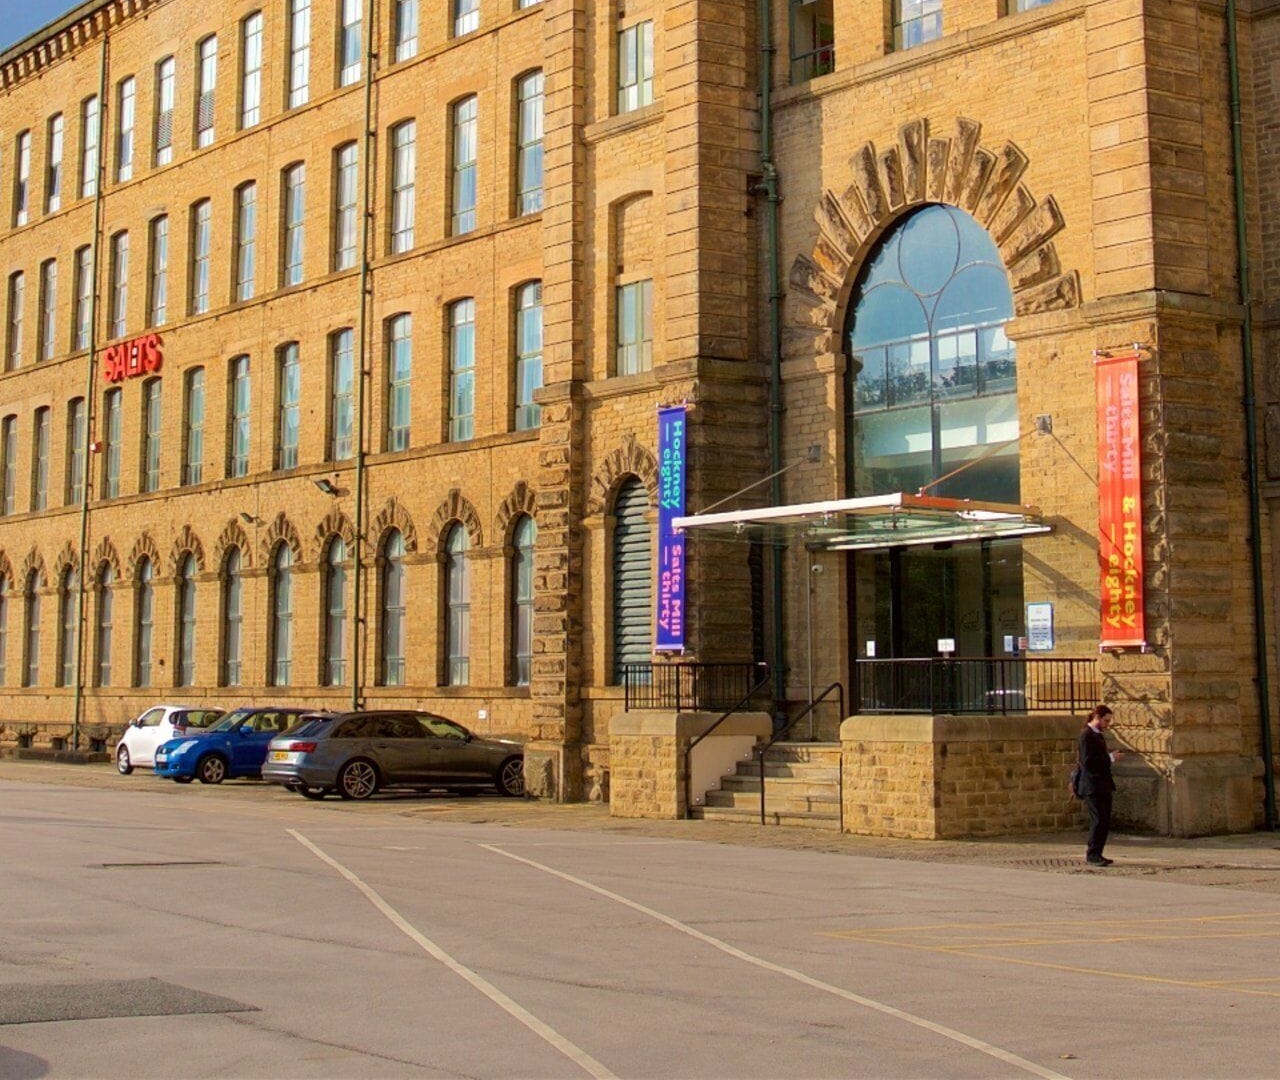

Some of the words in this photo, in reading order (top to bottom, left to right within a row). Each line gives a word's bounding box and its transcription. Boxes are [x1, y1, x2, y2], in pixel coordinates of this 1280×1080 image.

[104, 333, 163, 383] SALTS
[1120, 373, 1133, 428] Salts
[661, 448, 672, 509] eighty
[671, 421, 682, 508] Hockney
[1122, 437, 1135, 479] Mill
[1122, 496, 1135, 514] &
[671, 545, 681, 593] Salts
[1105, 554, 1122, 629] eighty
[1121, 521, 1138, 628] Hockney
[659, 571, 671, 629] thirty
[671, 600, 680, 636] Mill
